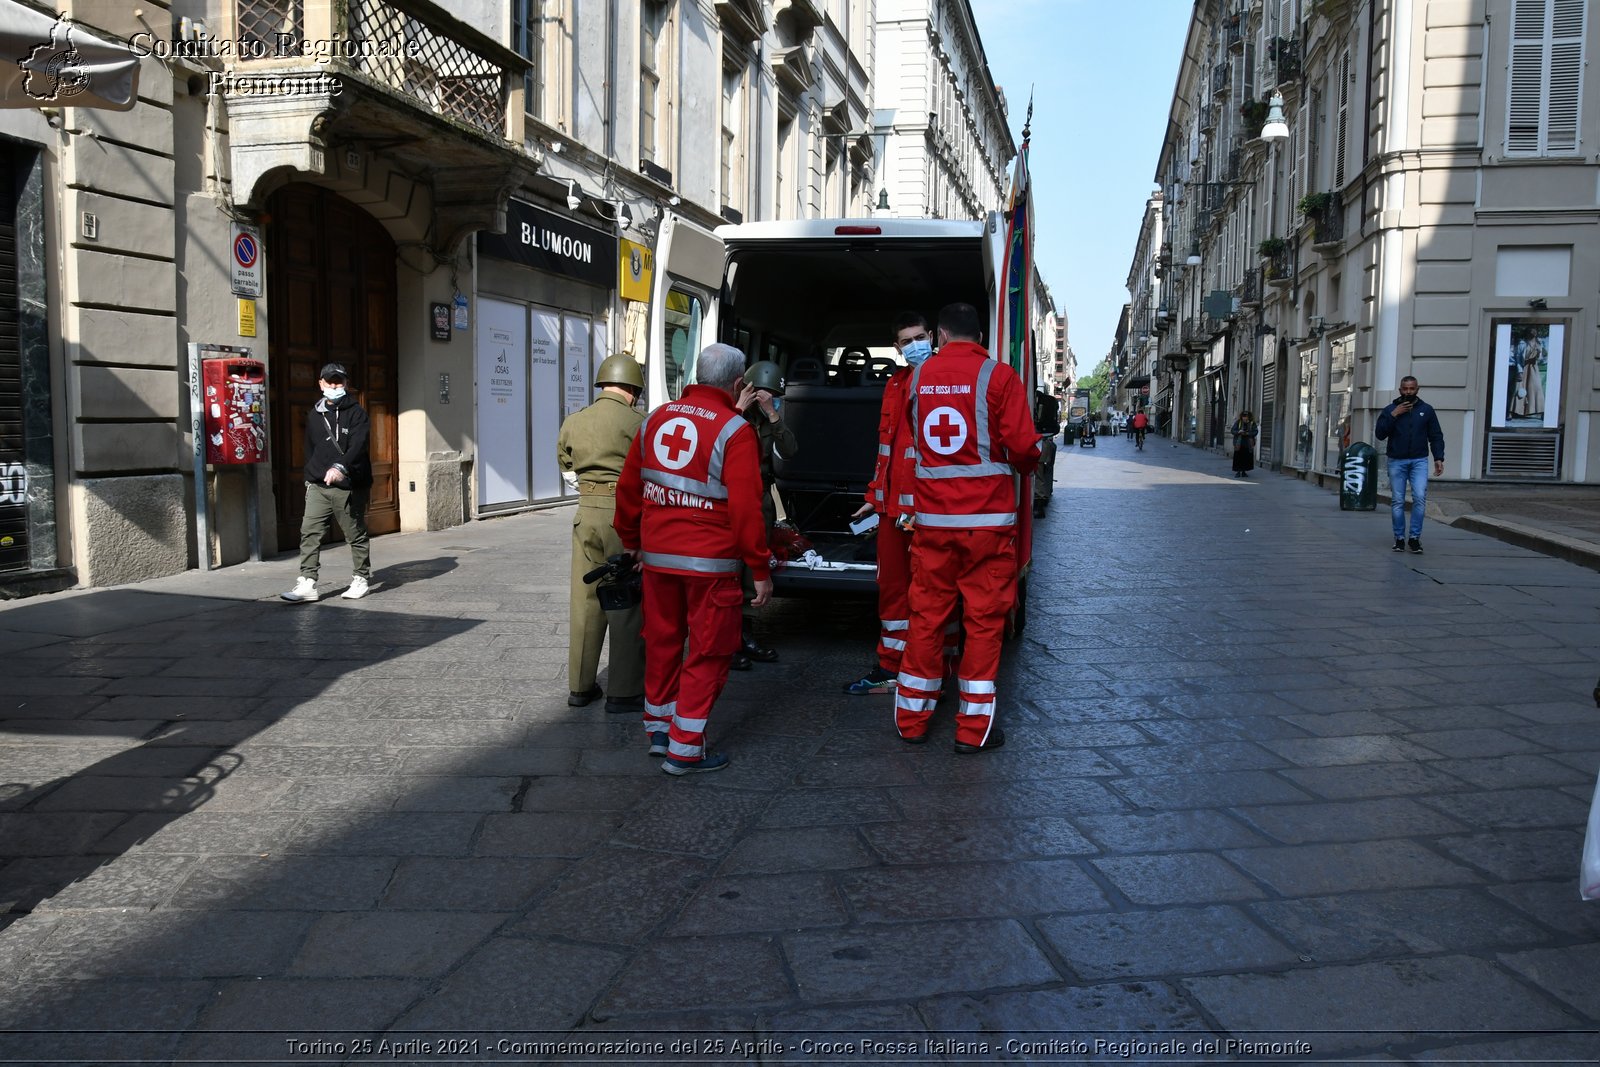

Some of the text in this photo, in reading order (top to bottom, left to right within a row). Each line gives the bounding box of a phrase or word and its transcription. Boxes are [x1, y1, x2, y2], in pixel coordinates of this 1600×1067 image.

[521, 221, 592, 264] BLUMOON
[237, 270, 254, 278] passo
[233, 278, 259, 288] carrabile
[920, 384, 971, 394] CROCE ROSSA ITALIANA
[666, 404, 718, 421] CROCE ROSSA ITALIANA
[668, 489, 713, 510] STAMPA
